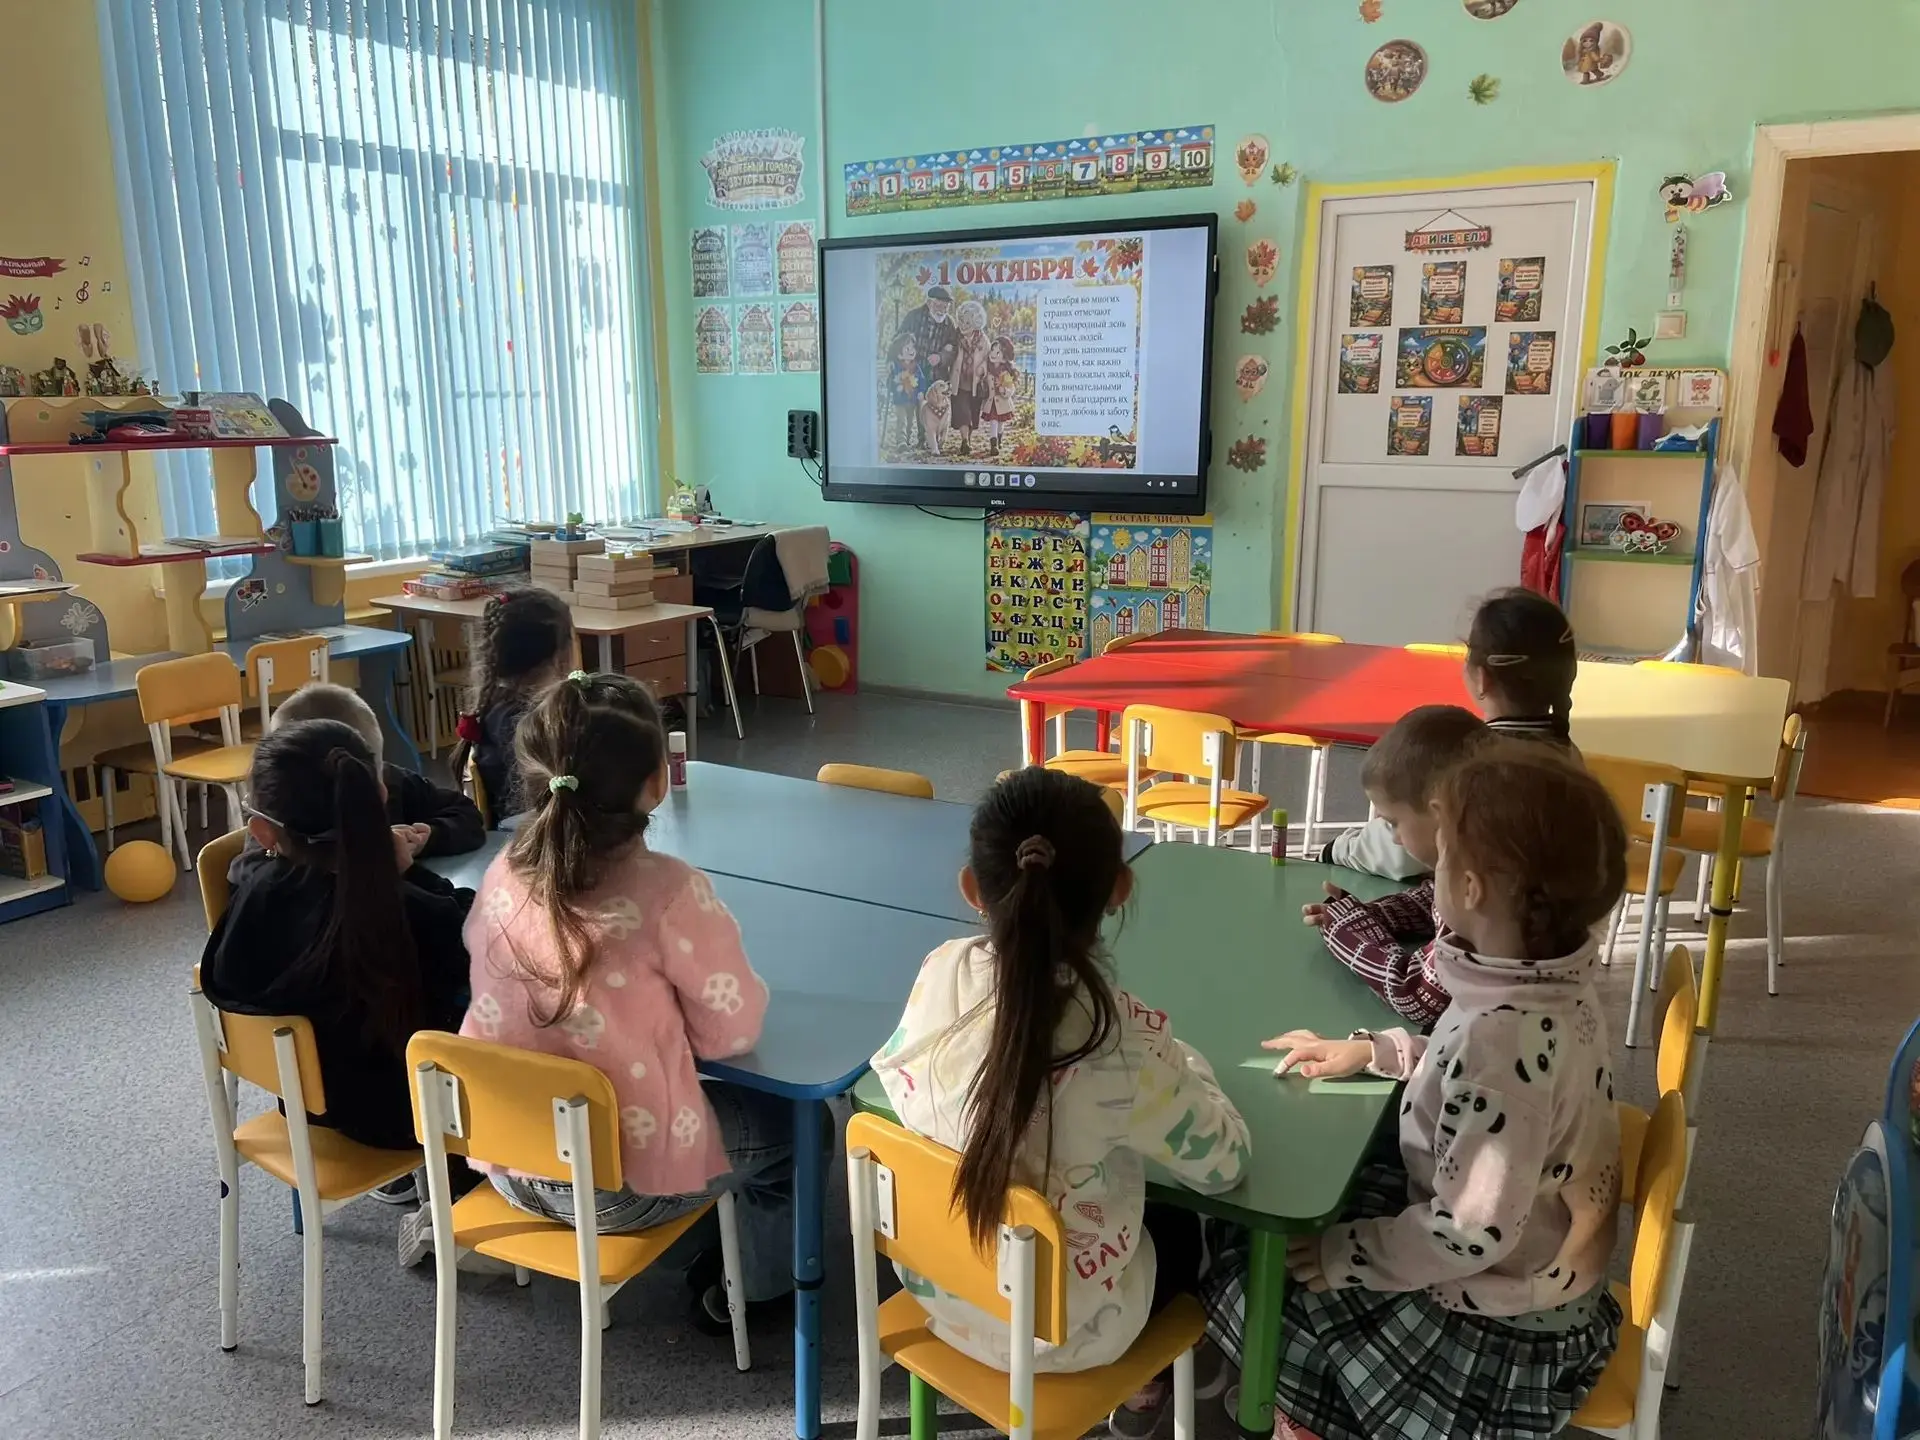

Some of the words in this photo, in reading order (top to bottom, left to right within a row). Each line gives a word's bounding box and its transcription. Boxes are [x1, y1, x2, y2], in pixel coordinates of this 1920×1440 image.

[886, 179, 893, 192] 1
[918, 179, 924, 190] 2
[948, 174, 956, 188] 3
[978, 173, 988, 189] 4
[1012, 168, 1021, 183] 5
[1079, 163, 1090, 179] 7
[1115, 156, 1124, 171] 8
[1152, 154, 1162, 168] 9
[1187, 151, 1204, 167] 10
[1412, 233, 1437, 246] ДНИ
[1440, 230, 1488, 244] НЕДЕЛИ
[938, 261, 950, 285] 1
[956, 256, 1075, 284] ОКТЯБРЯ
[1523, 298, 1538, 318] 3
[1532, 373, 1547, 390] 4
[1483, 438, 1495, 454] 5
[1001, 515, 1075, 528] АЗБУКА
[1110, 514, 1150, 522] СОСТАВ
[1152, 514, 1192, 524] ЧИСЛА
[991, 537, 1002, 549] А
[1012, 537, 1021, 550] Б
[1032, 538, 1042, 550] В
[1053, 539, 1063, 551] Г
[1072, 540, 1085, 553] Д
[990, 556, 1000, 568] Е
[1008, 553, 1019, 568] Ё
[1027, 557, 1044, 570] Ж
[1053, 559, 1064, 570] З
[1072, 560, 1084, 571] И
[990, 572, 1002, 586] Й
[1010, 576, 1022, 587] К
[1030, 577, 1043, 588] Л
[1051, 578, 1064, 589] М
[1072, 579, 1084, 591] Н
[990, 593, 1001, 605] О
[1012, 595, 1023, 606] П
[1033, 596, 1043, 607] Р
[1053, 597, 1064, 608] С
[1073, 598, 1084, 610] Т
[991, 612, 1002, 624] У
[1010, 613, 1022, 625] Ф
[1031, 614, 1043, 627] Х
[1052, 616, 1064, 629] Ц
[1072, 617, 1084, 629] Ч
[991, 631, 1007, 642] Ш
[1018, 632, 1034, 646] Щ
[1047, 634, 1060, 646] Ъ
[1067, 636, 1083, 648] Ы
[1000, 649, 1010, 661] Ь
[1018, 651, 1029, 662] Э
[1038, 653, 1054, 664] Ю
